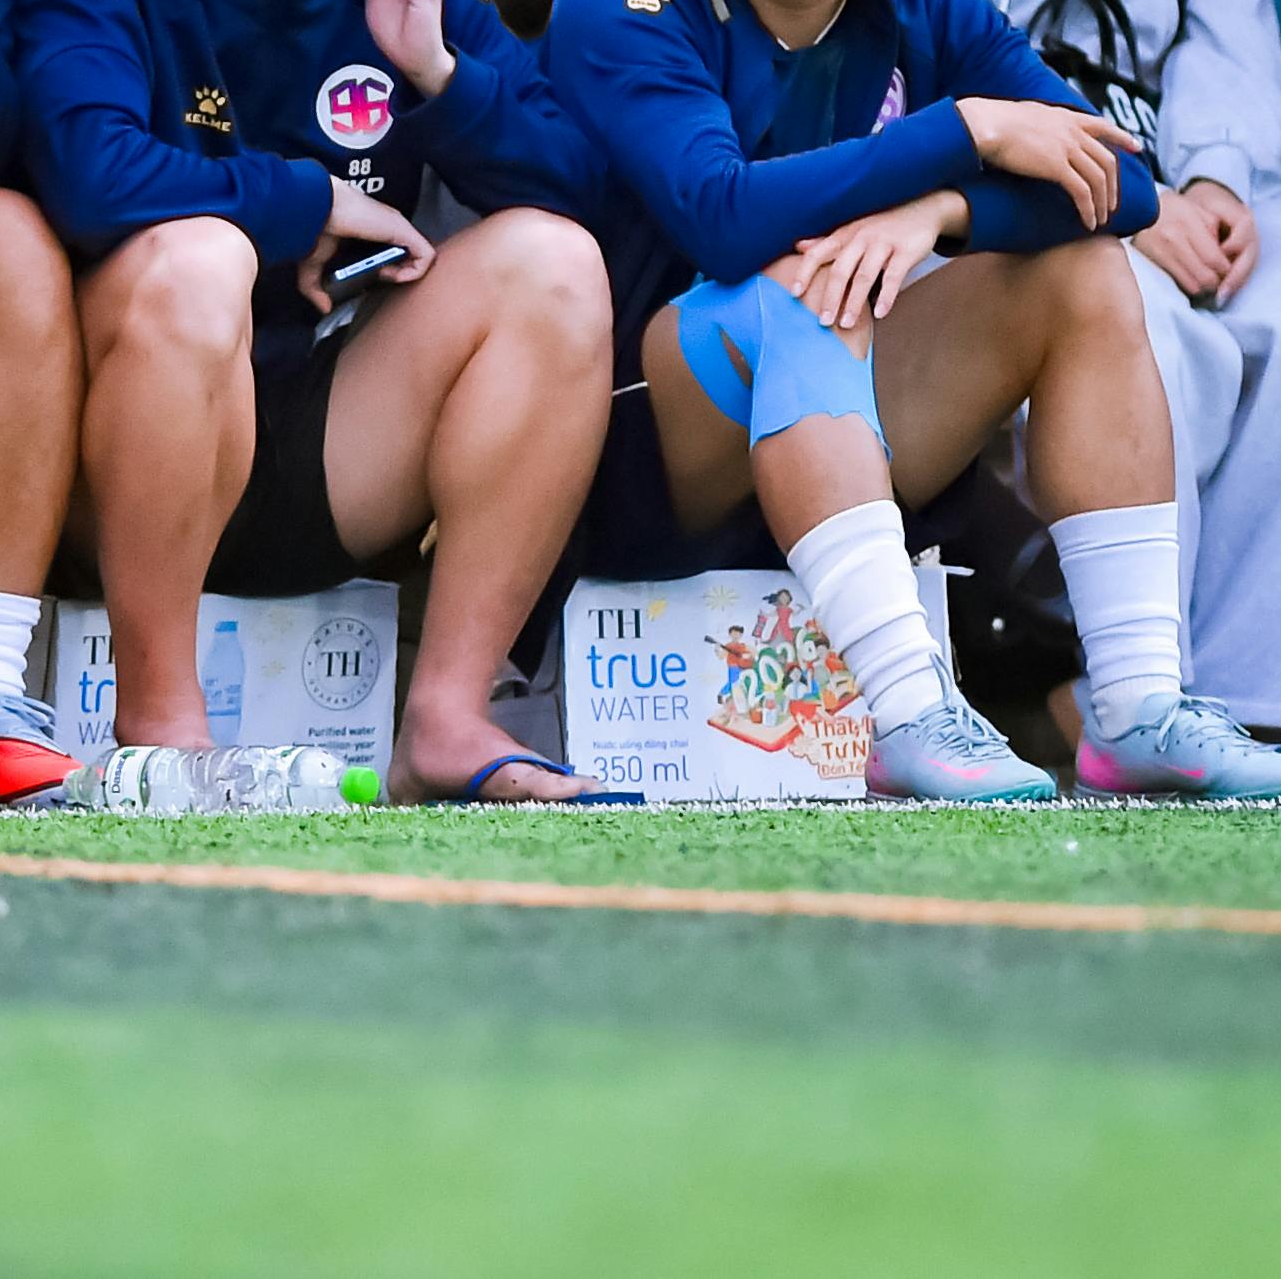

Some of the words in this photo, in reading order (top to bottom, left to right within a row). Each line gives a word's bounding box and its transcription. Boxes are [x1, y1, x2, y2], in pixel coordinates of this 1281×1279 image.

[185, 112, 232, 132] KELME
[348, 158, 372, 177] 88
[342, 176, 386, 195] KD
[587, 607, 643, 639] TH
[320, 650, 362, 678] TH
[586, 644, 687, 689] true
[79, 670, 116, 713] tr
[590, 695, 690, 722] WATER
[78, 720, 115, 746] WA
[308, 726, 347, 737] Purified
[348, 726, 376, 736] water
[593, 755, 644, 783] 350
[653, 754, 691, 782] ml
